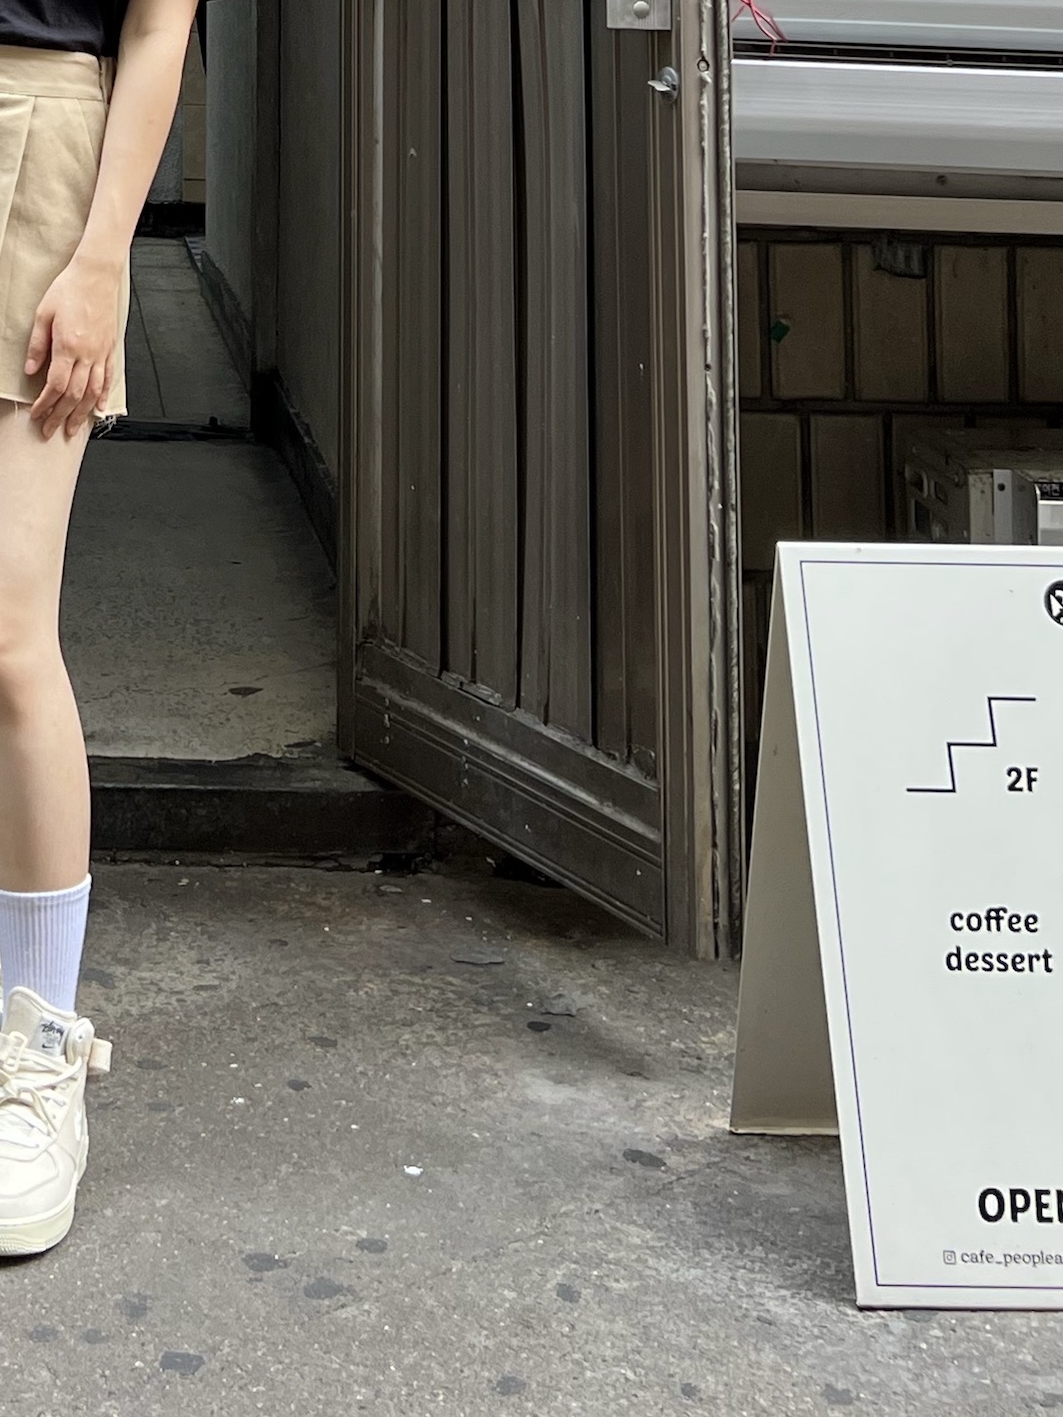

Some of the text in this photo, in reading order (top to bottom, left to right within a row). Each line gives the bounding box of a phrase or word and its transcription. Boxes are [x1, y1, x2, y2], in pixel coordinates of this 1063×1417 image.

[1006, 767, 1038, 793] 2F
[950, 907, 1040, 933] coffee
[946, 946, 1054, 973] dessert
[978, 1187, 1063, 1223] OPE
